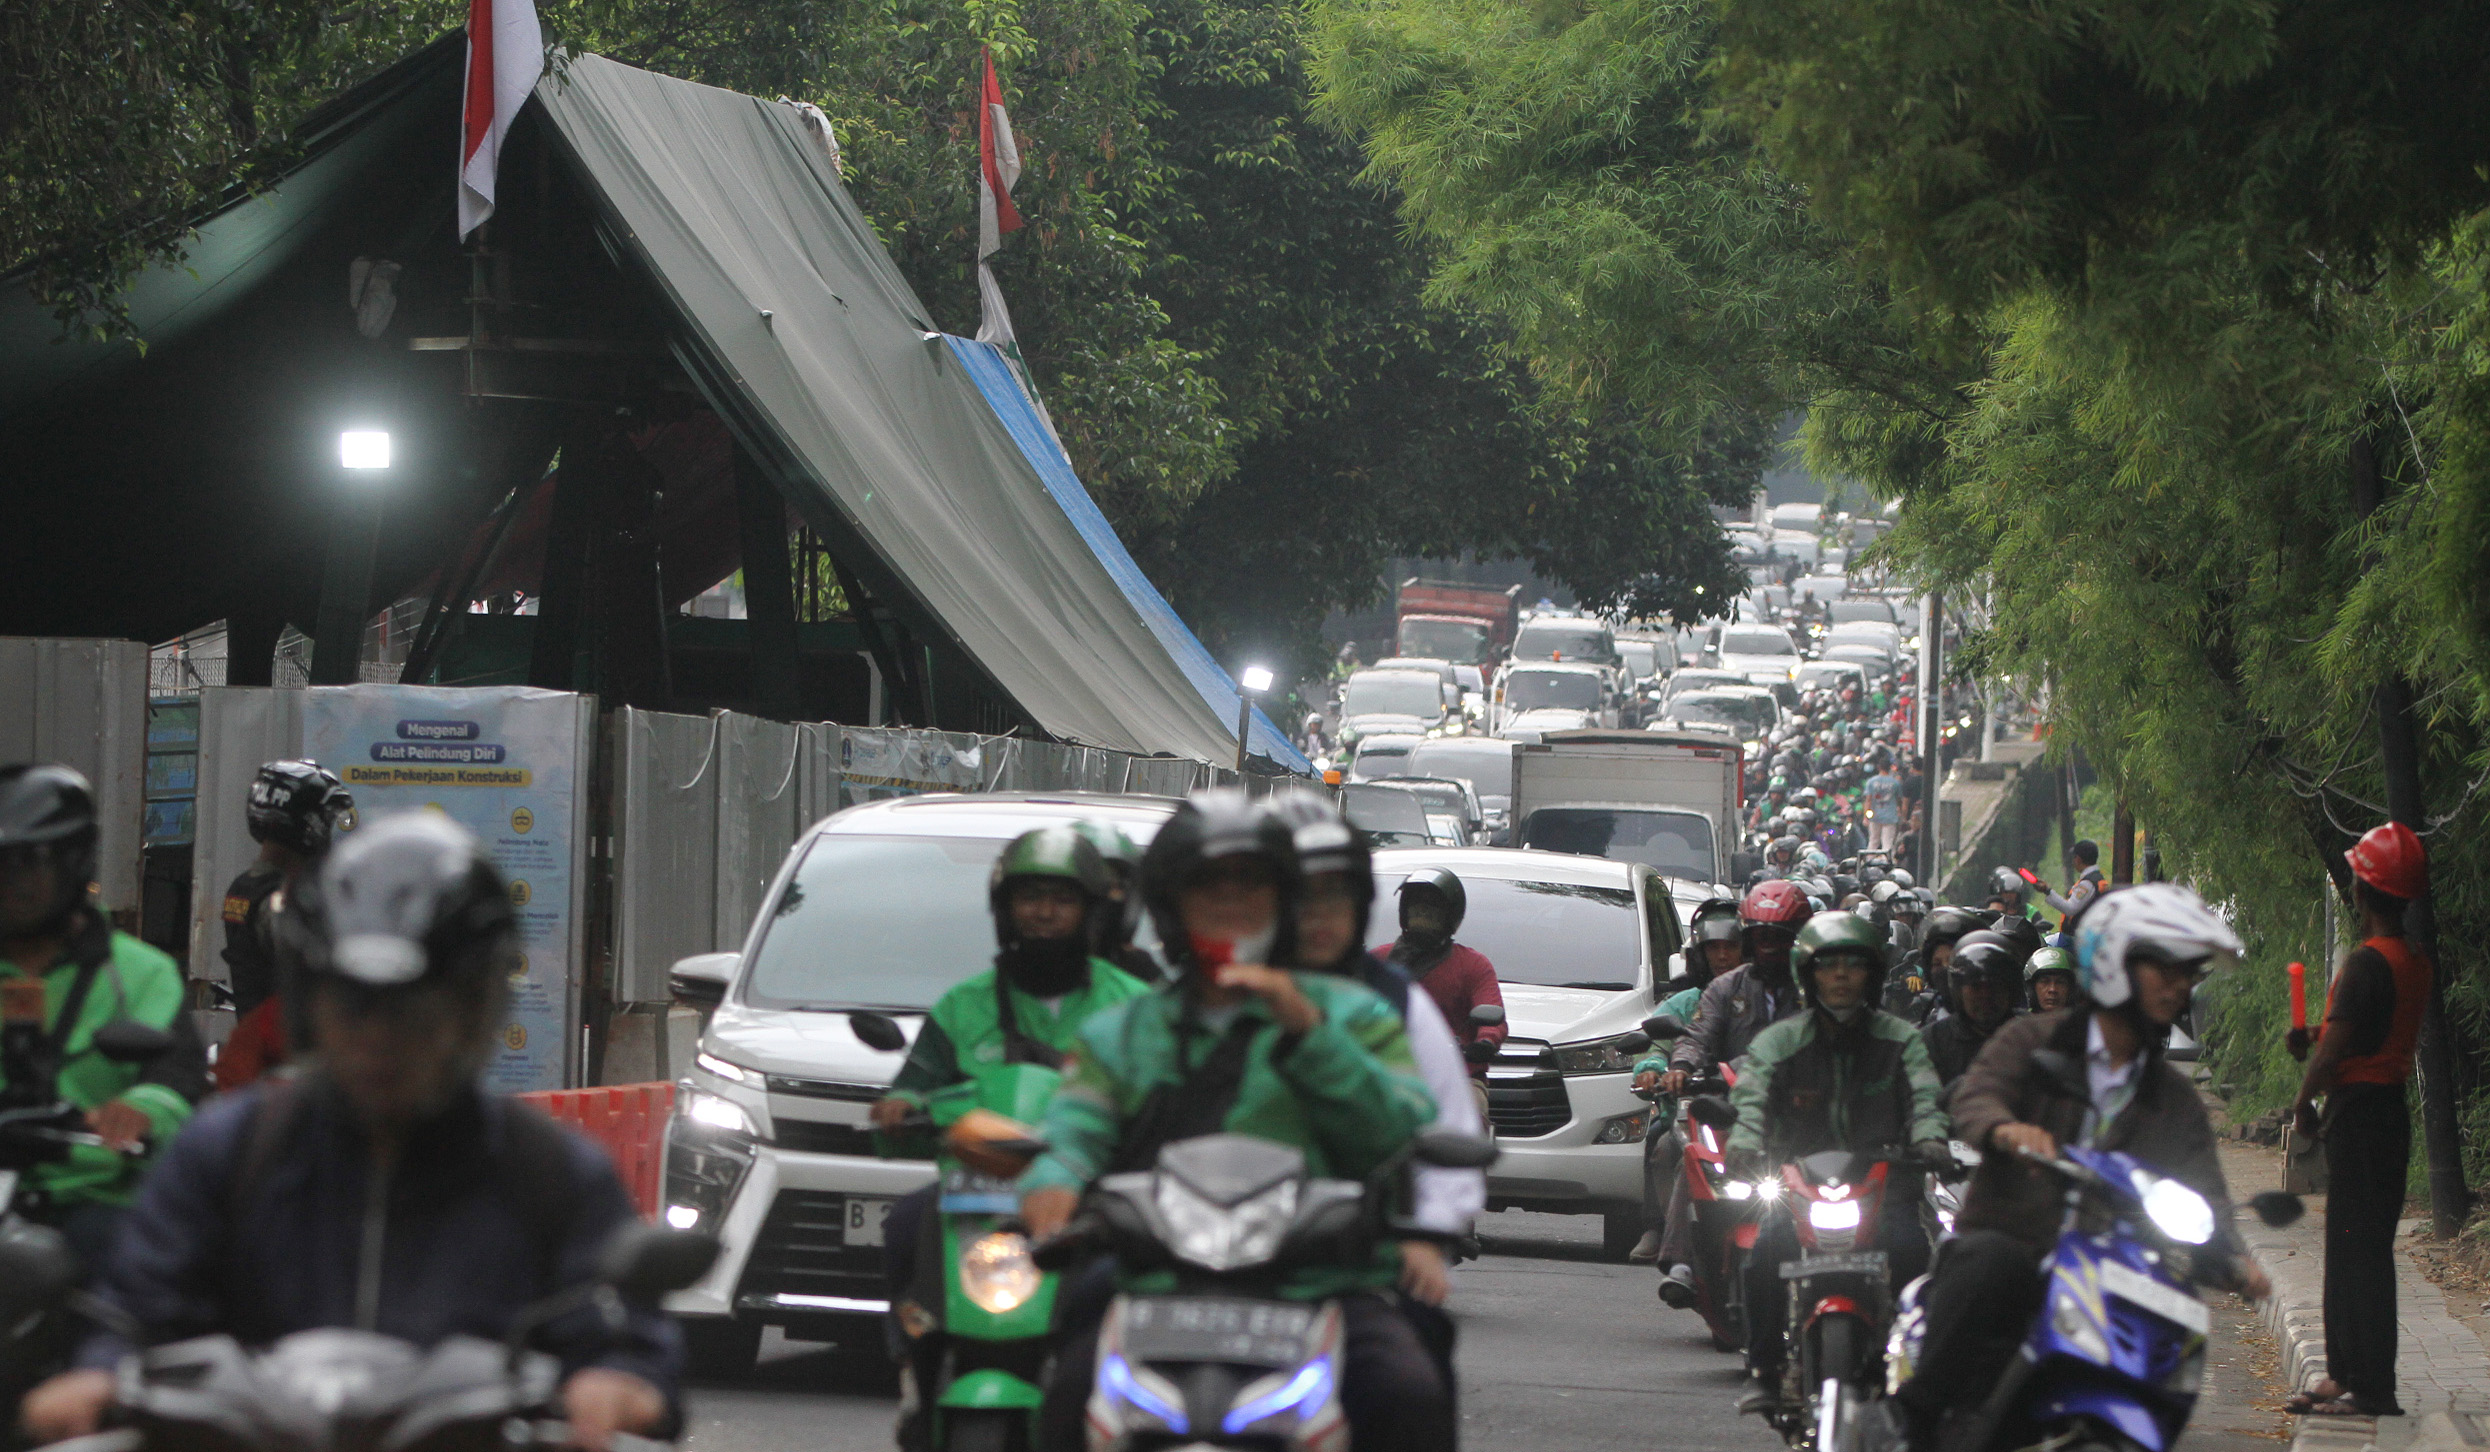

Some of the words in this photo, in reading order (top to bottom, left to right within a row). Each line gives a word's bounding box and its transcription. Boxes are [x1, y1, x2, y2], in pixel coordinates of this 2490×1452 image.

[407, 723, 468, 738] Mengenal
[379, 746, 406, 759] Alat
[408, 747, 471, 762] Pelindung
[473, 747, 497, 761] Diri
[351, 768, 392, 781] Dalam
[394, 769, 455, 784] Pekerjaan
[457, 770, 522, 783] Konstruksi
[271, 787, 292, 807] PP
[851, 1203, 865, 1229] B
